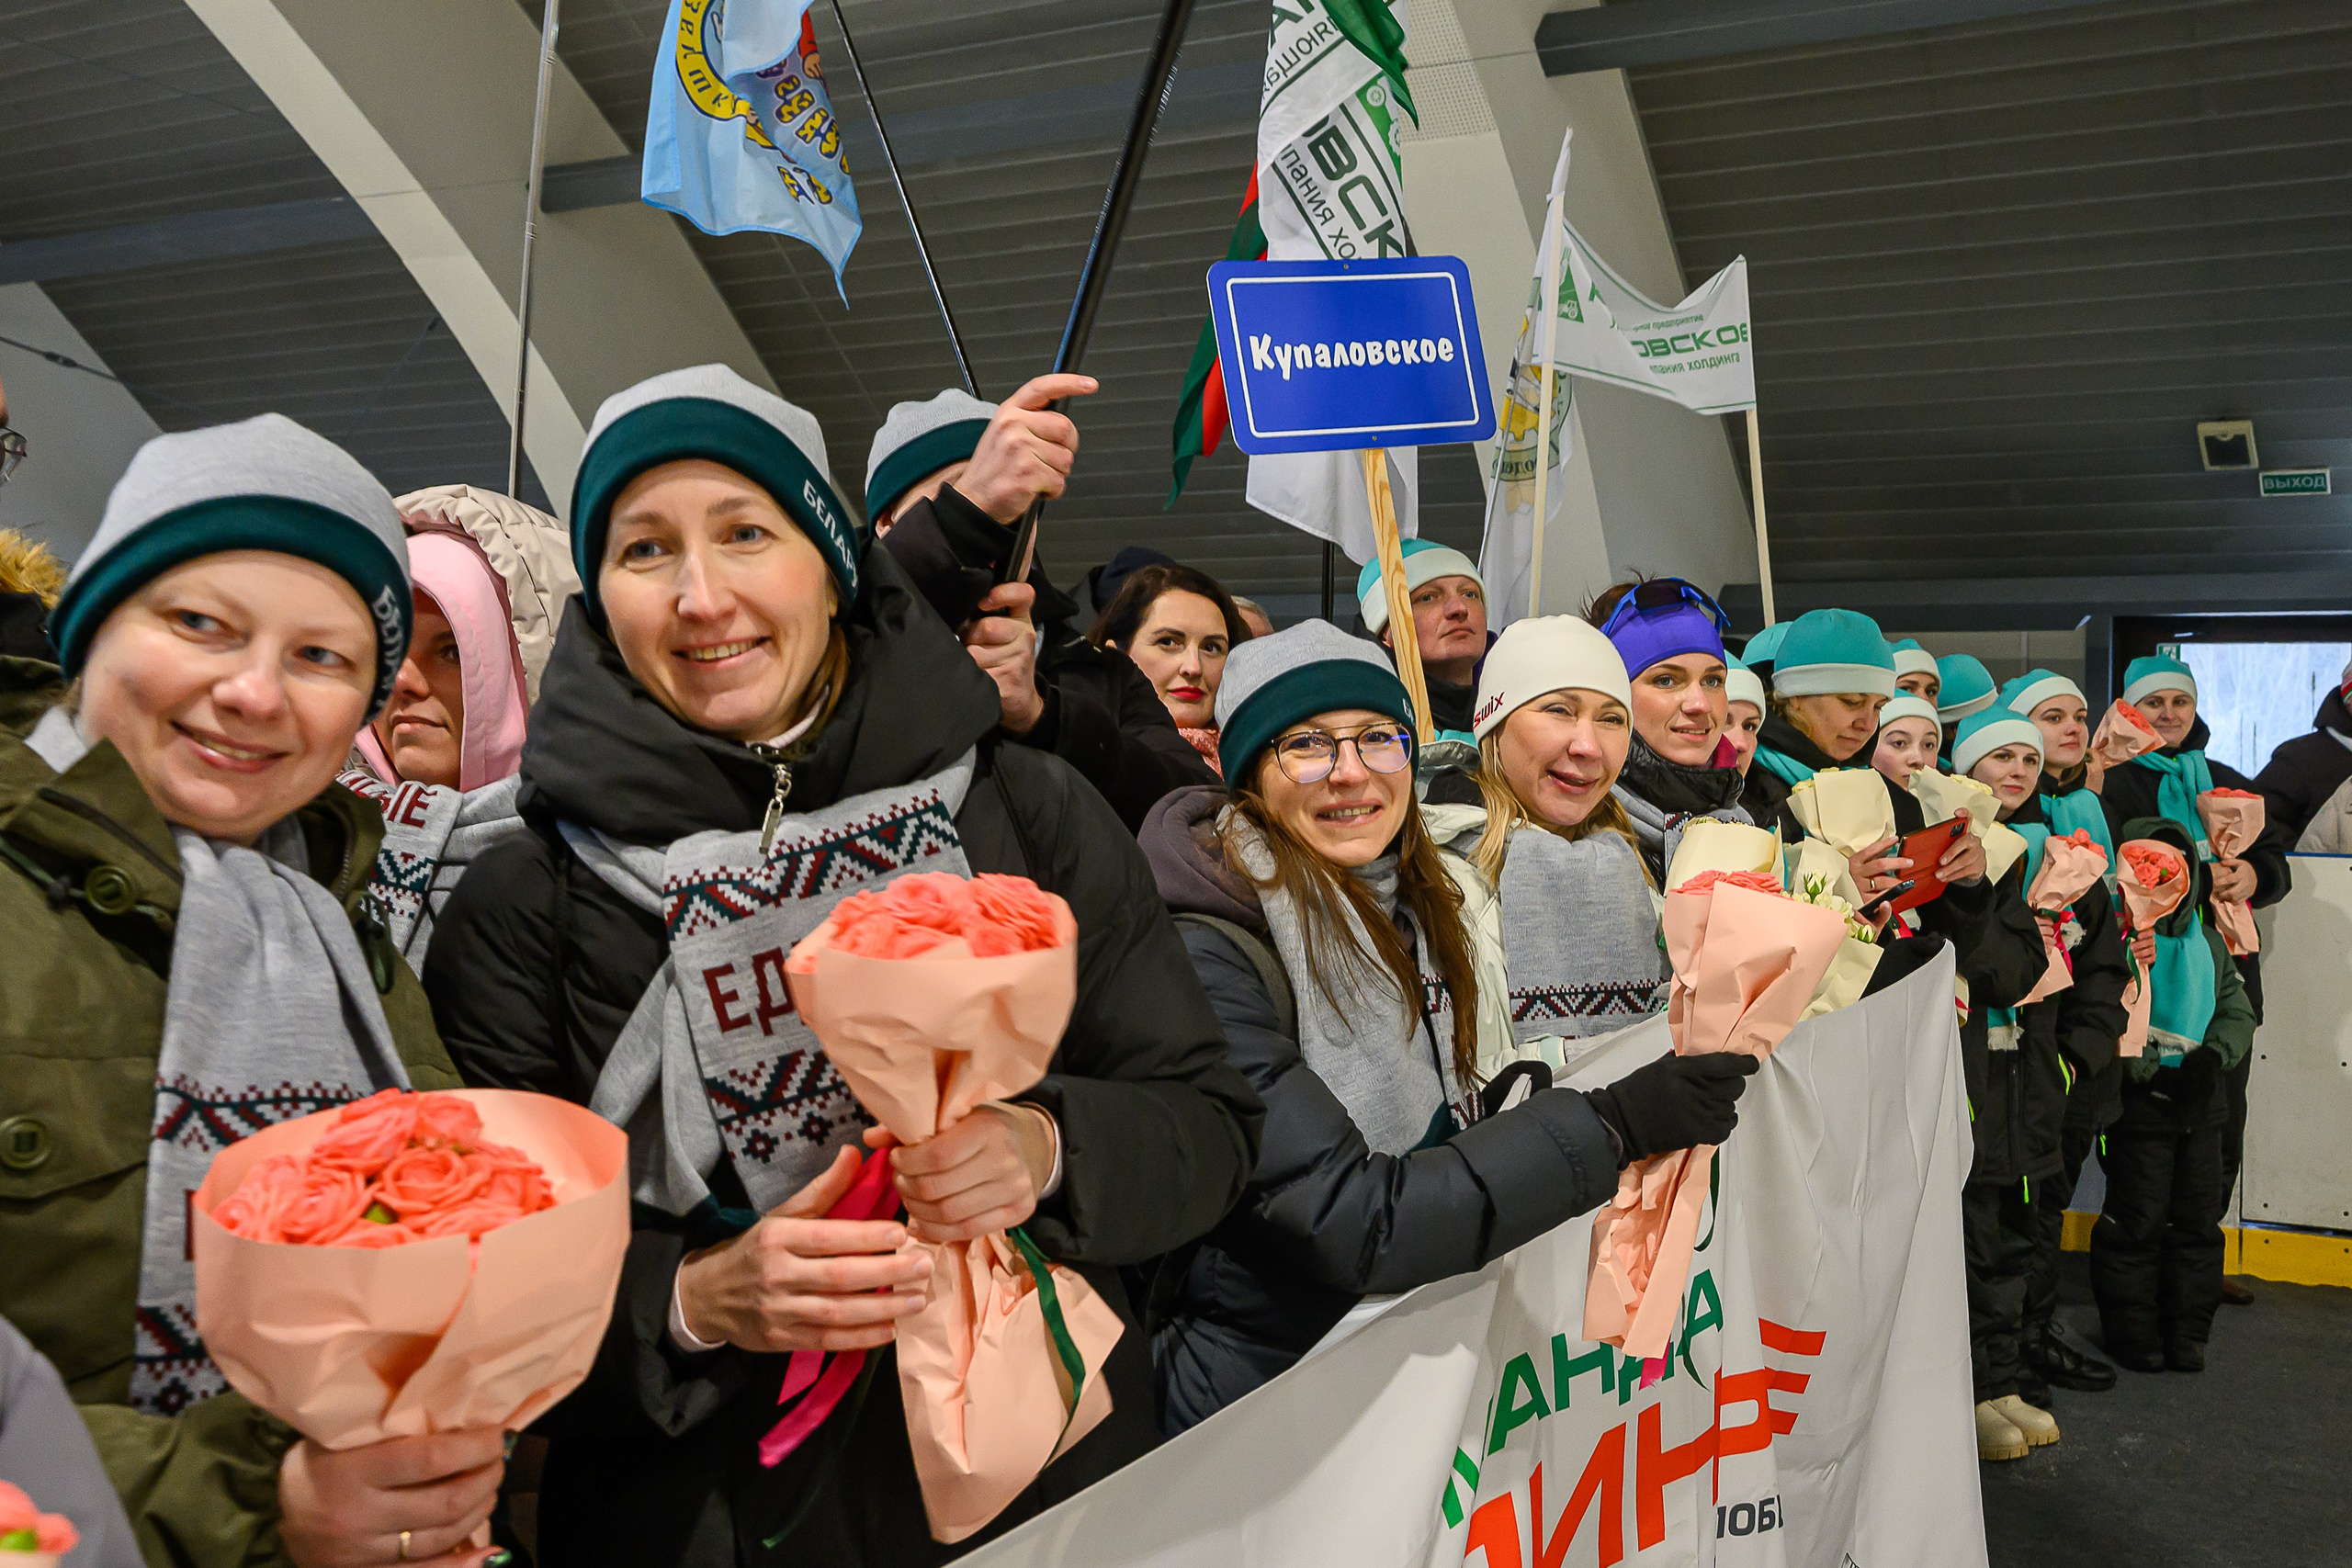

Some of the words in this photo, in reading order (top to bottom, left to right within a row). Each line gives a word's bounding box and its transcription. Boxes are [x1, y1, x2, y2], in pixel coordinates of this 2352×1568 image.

[1280, 144, 1335, 226] пания
[1249, 333, 1454, 381] Купаловское
[1687, 352, 1740, 371] холдинга
[2263, 475, 2326, 490] ВЫХОД
